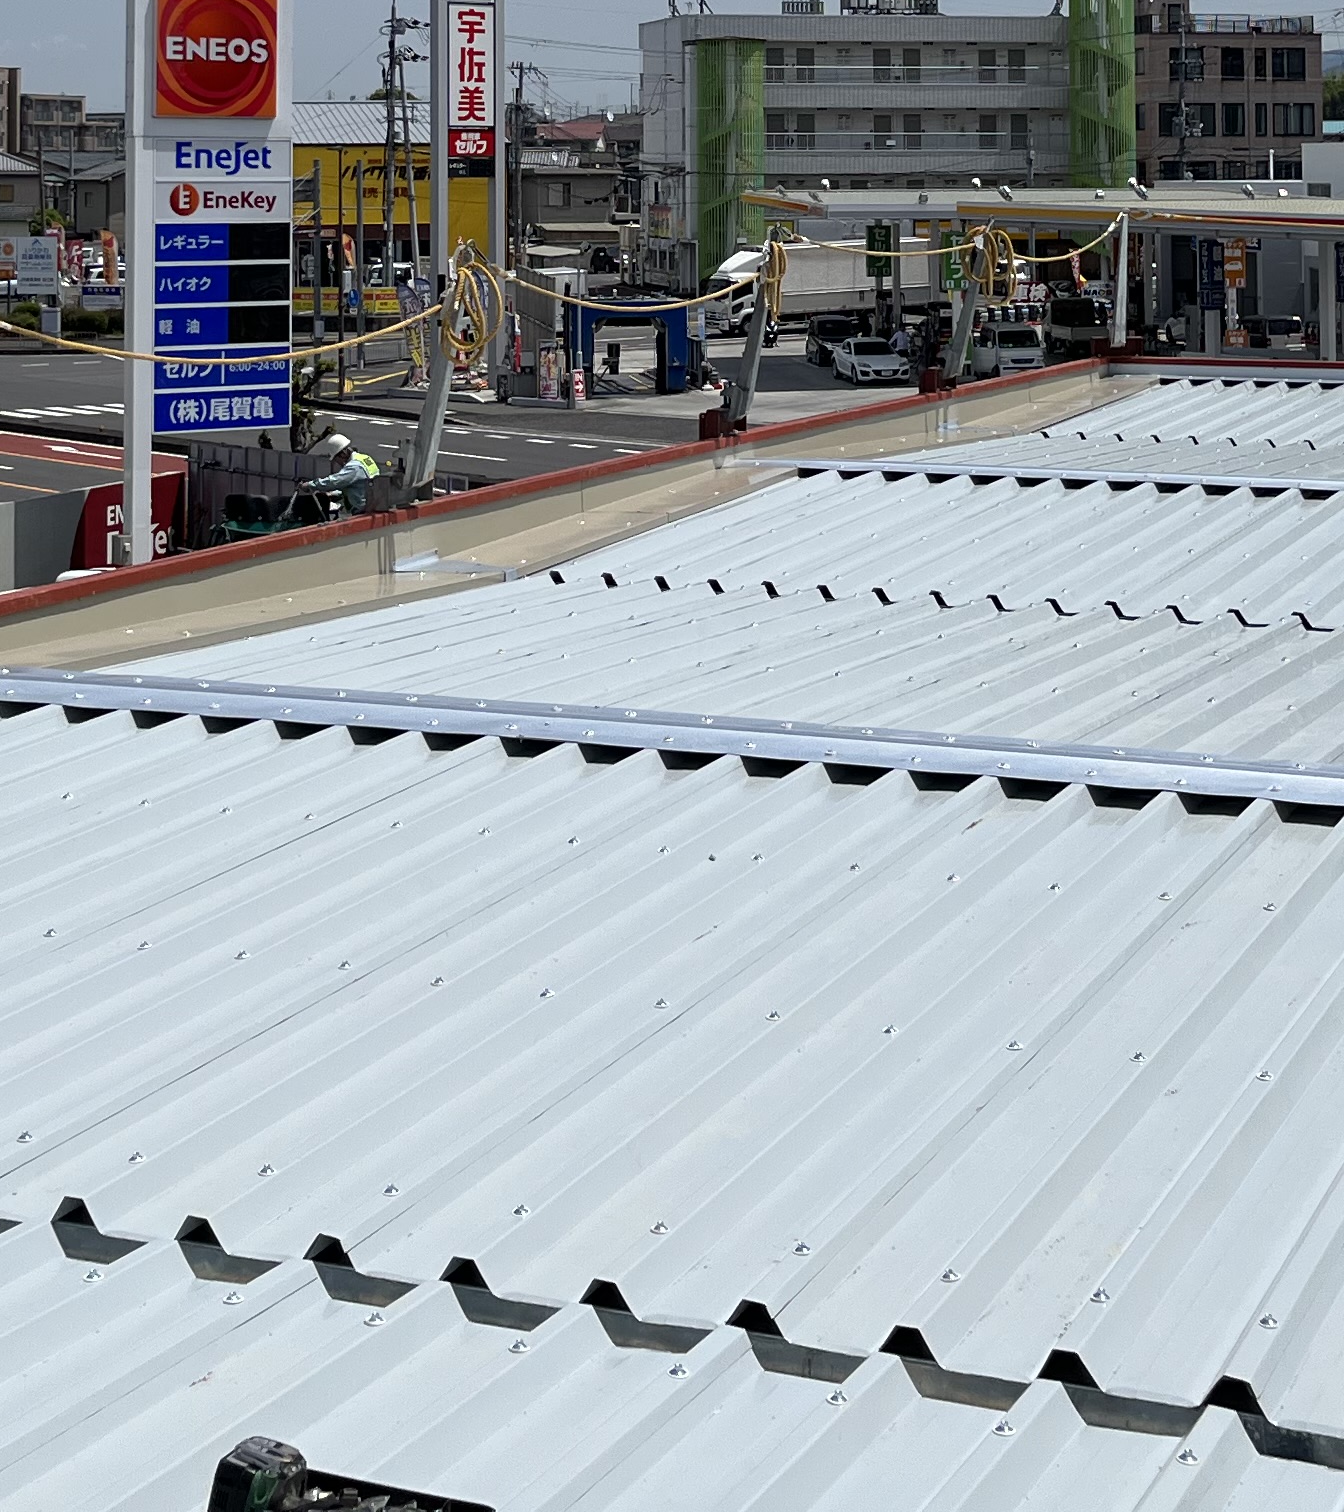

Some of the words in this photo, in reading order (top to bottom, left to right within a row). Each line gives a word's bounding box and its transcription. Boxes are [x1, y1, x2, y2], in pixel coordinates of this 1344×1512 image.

[166, 36, 269, 63] ENEOS
[458, 9, 486, 122] 宇佐美
[455, 140, 487, 154] セルフ
[203, 190, 277, 213] EneKey
[160, 236, 224, 250] レギュラー
[160, 277, 212, 292] ハイオク
[169, 396, 274, 424] (株)尾賀亀
